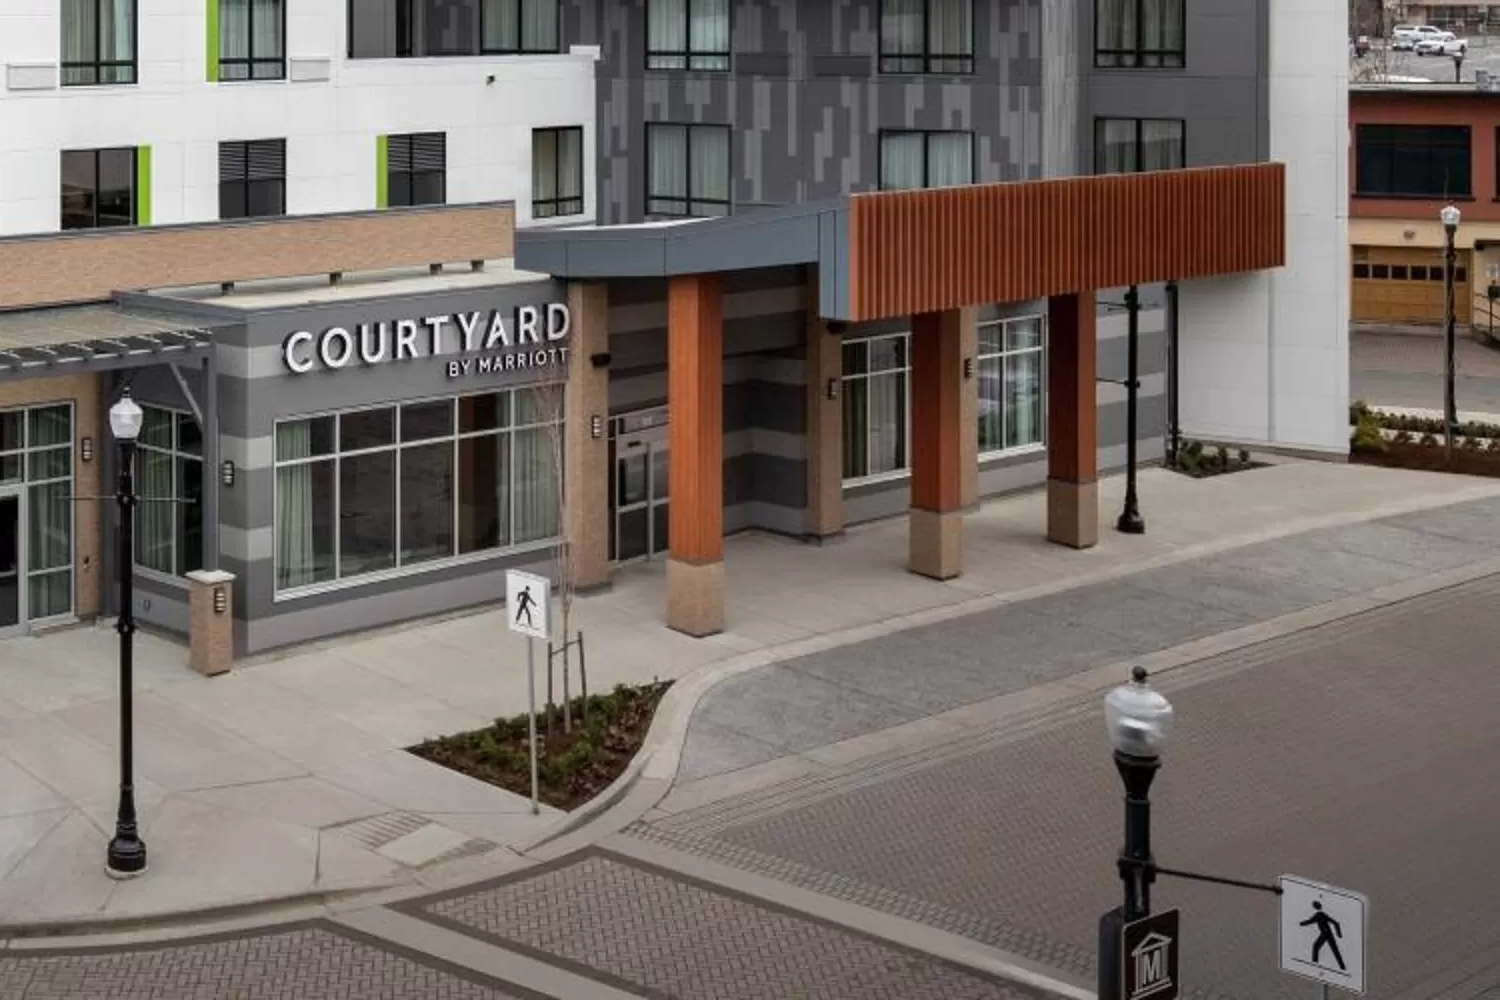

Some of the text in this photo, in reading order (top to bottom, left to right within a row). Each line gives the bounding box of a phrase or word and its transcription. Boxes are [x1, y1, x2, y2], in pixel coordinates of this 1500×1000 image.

[283, 302, 571, 374] COURTYARD
[448, 347, 570, 378] BY MARRIOTT
